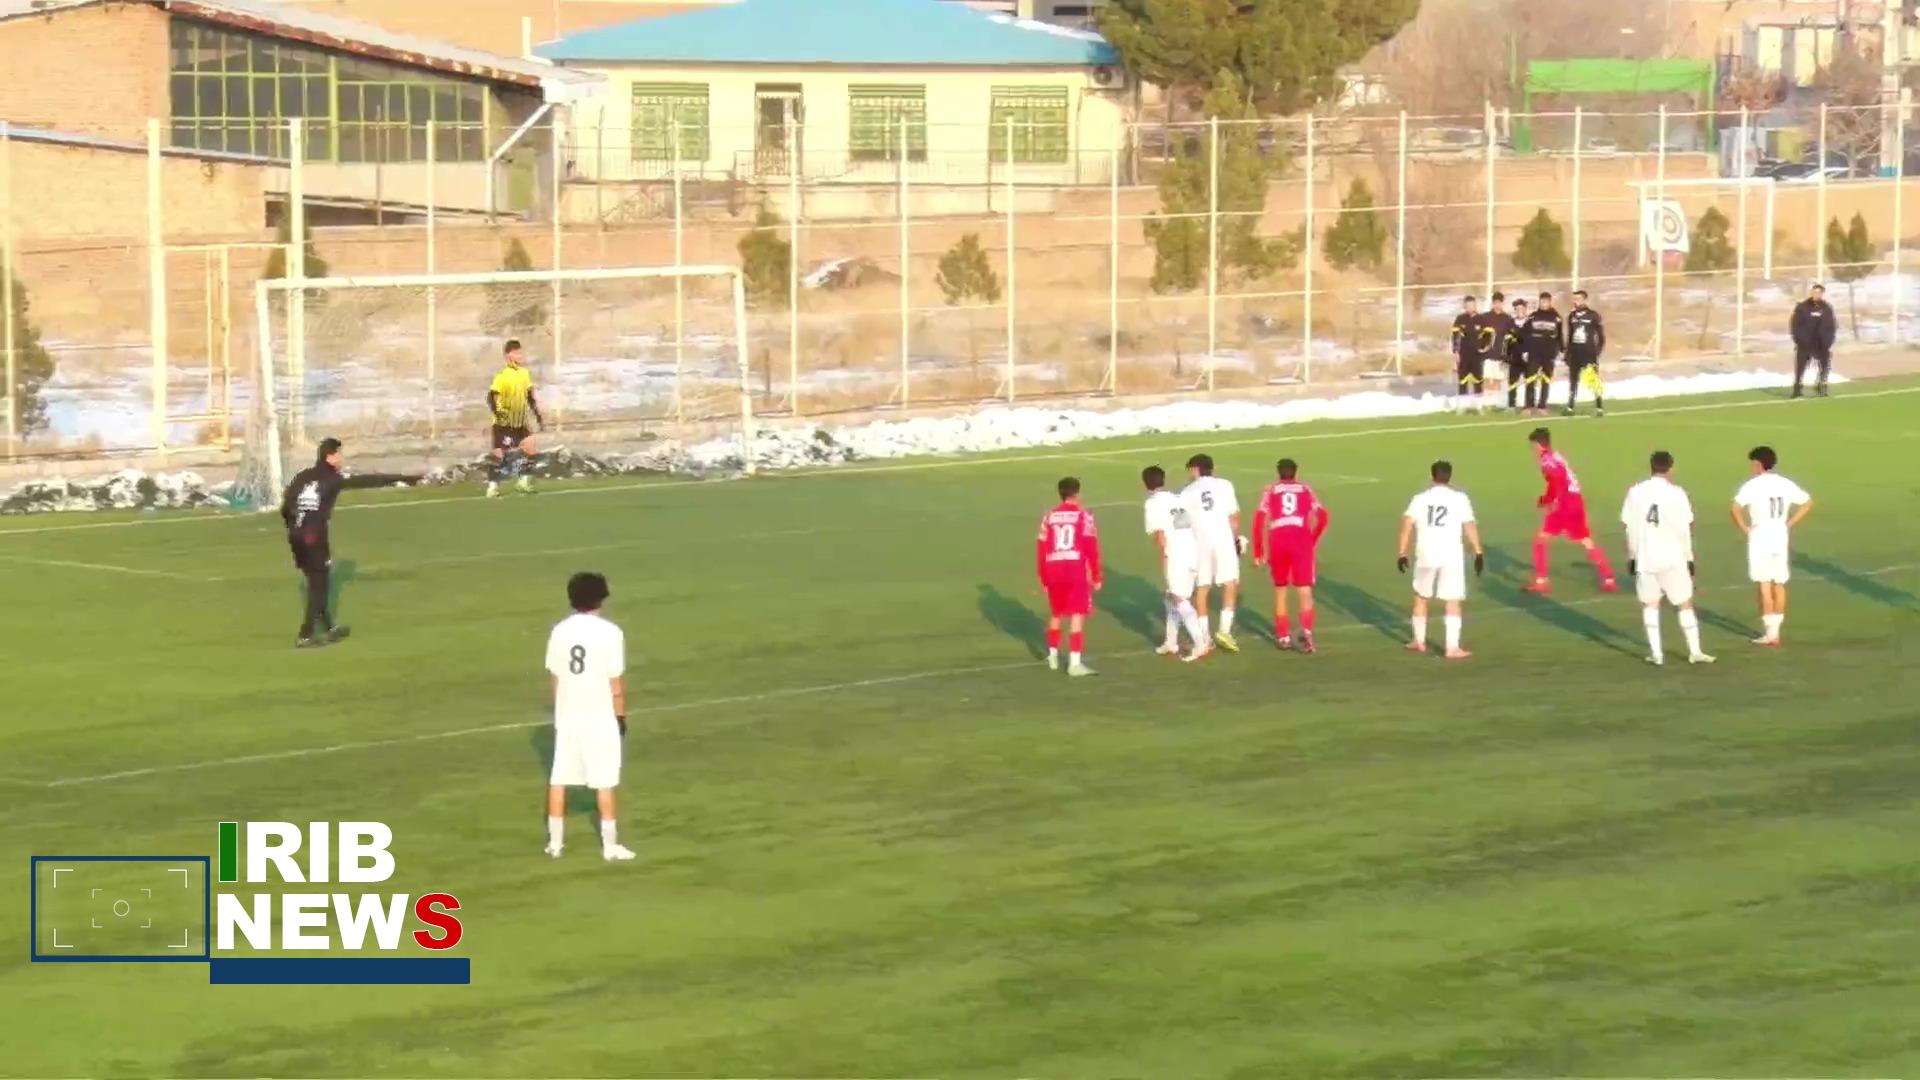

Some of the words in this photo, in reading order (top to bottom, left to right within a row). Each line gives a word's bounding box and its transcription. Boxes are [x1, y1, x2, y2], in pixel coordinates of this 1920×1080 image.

[1201, 490, 1215, 511] 5
[1281, 492, 1298, 516] 9
[1769, 496, 1785, 519] 11
[1427, 505, 1448, 527] 12
[1645, 504, 1660, 528] 4
[1053, 524, 1076, 550] 10
[569, 644, 586, 675] 8
